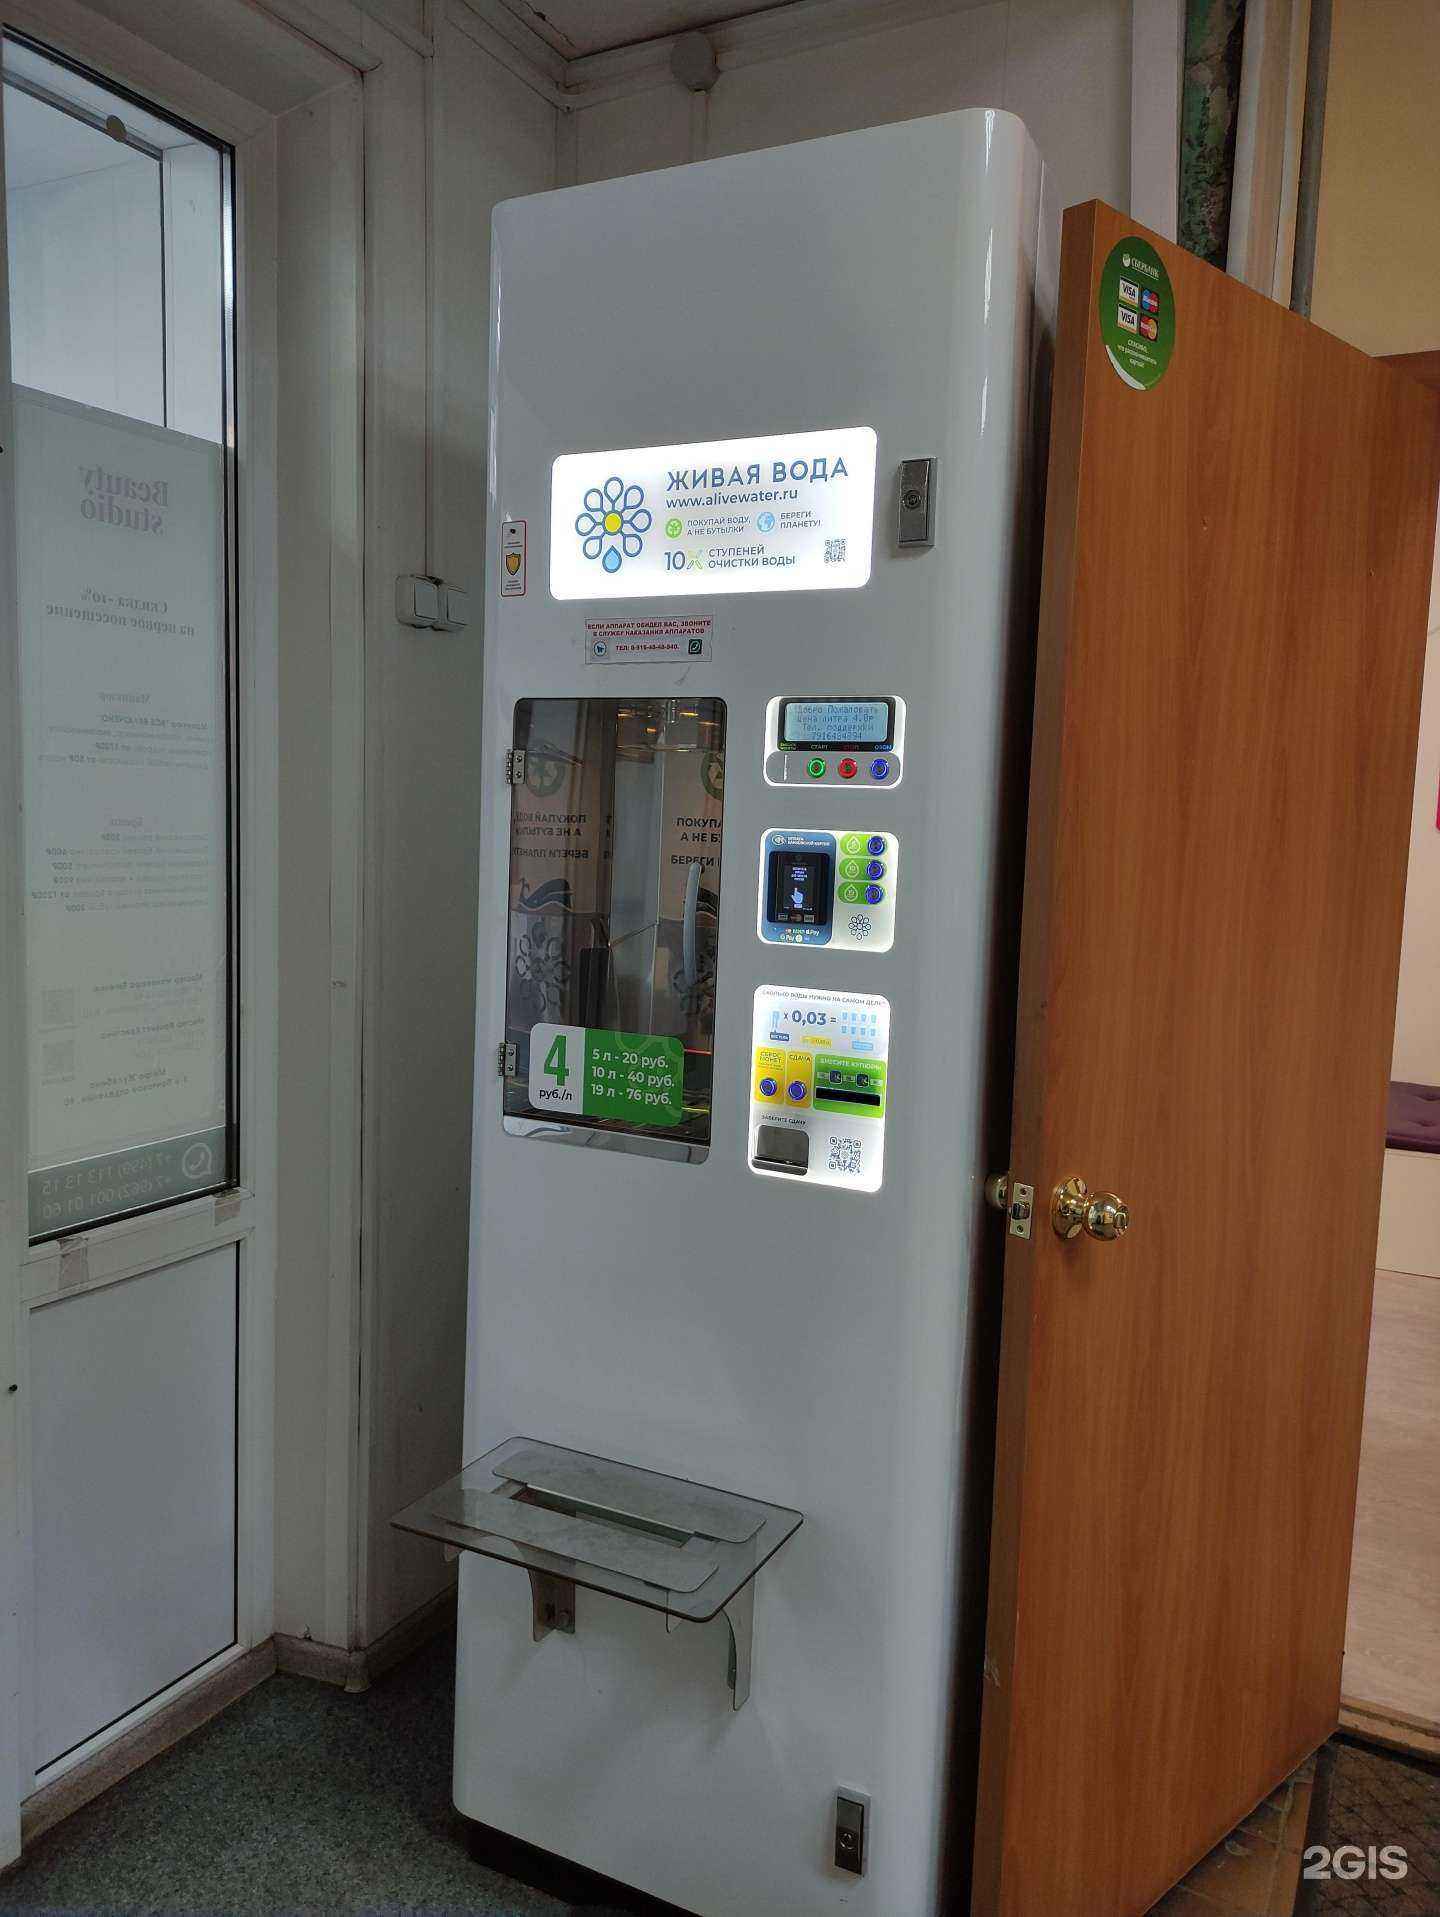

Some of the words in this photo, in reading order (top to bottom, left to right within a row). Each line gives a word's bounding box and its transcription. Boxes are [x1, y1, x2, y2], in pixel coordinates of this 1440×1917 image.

[1132, 258, 1160, 278] СБЕРБАНК
[1122, 283, 1136, 298] VISA
[1121, 310, 1135, 325] VISA
[667, 464, 760, 491] ЖИВАЯ
[772, 457, 849, 483] ВОДА
[665, 488, 798, 509] www.alivewater.ru
[687, 517, 725, 528] ПОКУПАЙ
[780, 511, 812, 520] БЕРЕГИ
[687, 528, 693, 536] А
[694, 527, 705, 536] НЕ
[706, 525, 745, 535] БУТЫЛКИ
[708, 543, 765, 558] СТУПЕНЕЙ
[664, 550, 686, 571] 10
[708, 557, 760, 569] ОЧИСТКИ
[762, 554, 796, 567] ВОДЫ
[606, 622, 635, 630] АППАРАТ
[792, 1009, 827, 1026] 0,03
[544, 1034, 570, 1087] 4
[592, 1049, 600, 1060] 5
[602, 1051, 612, 1062] л
[622, 1052, 639, 1064] 20
[641, 1054, 669, 1070] руб.
[592, 1066, 605, 1078] 10
[608, 1069, 617, 1080] л
[627, 1071, 645, 1084] 40
[647, 1073, 675, 1088] руб.
[539, 1089, 572, 1101] руб./л
[591, 1084, 604, 1096] 19
[606, 1087, 616, 1098] л
[626, 1088, 642, 1101] 76
[645, 1091, 672, 1105] руб.
